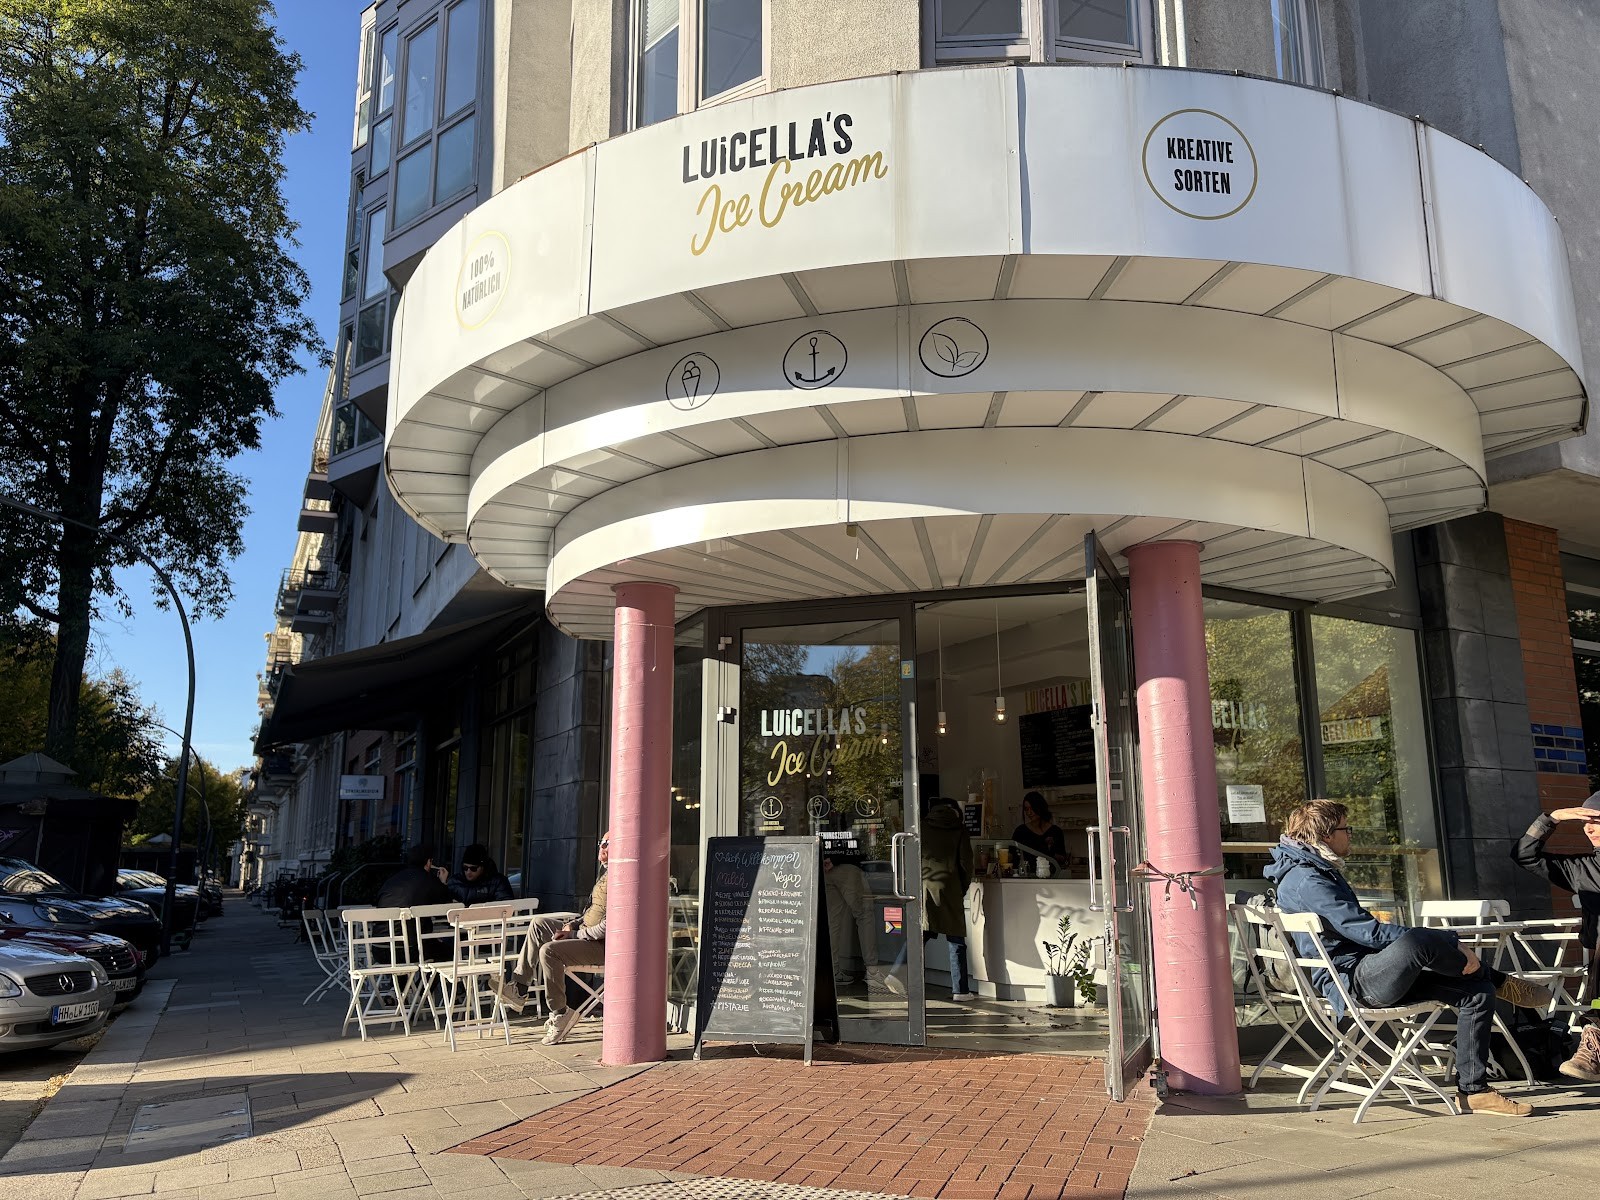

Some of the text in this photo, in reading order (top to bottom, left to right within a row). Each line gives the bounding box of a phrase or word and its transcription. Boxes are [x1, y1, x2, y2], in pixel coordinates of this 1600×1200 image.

[1167, 137, 1234, 163] KREATIVE
[1174, 168, 1231, 194] SORTEN
[690, 150, 888, 256] Ice Cream
[470, 250, 495, 281] 100%
[462, 271, 501, 311] NATÜRLICH
[767, 740, 807, 786] Ice
[772, 871, 801, 888] Vegan
[58, 1006, 70, 1020] HH
[718, 1002, 749, 1011] PISTAZIE
